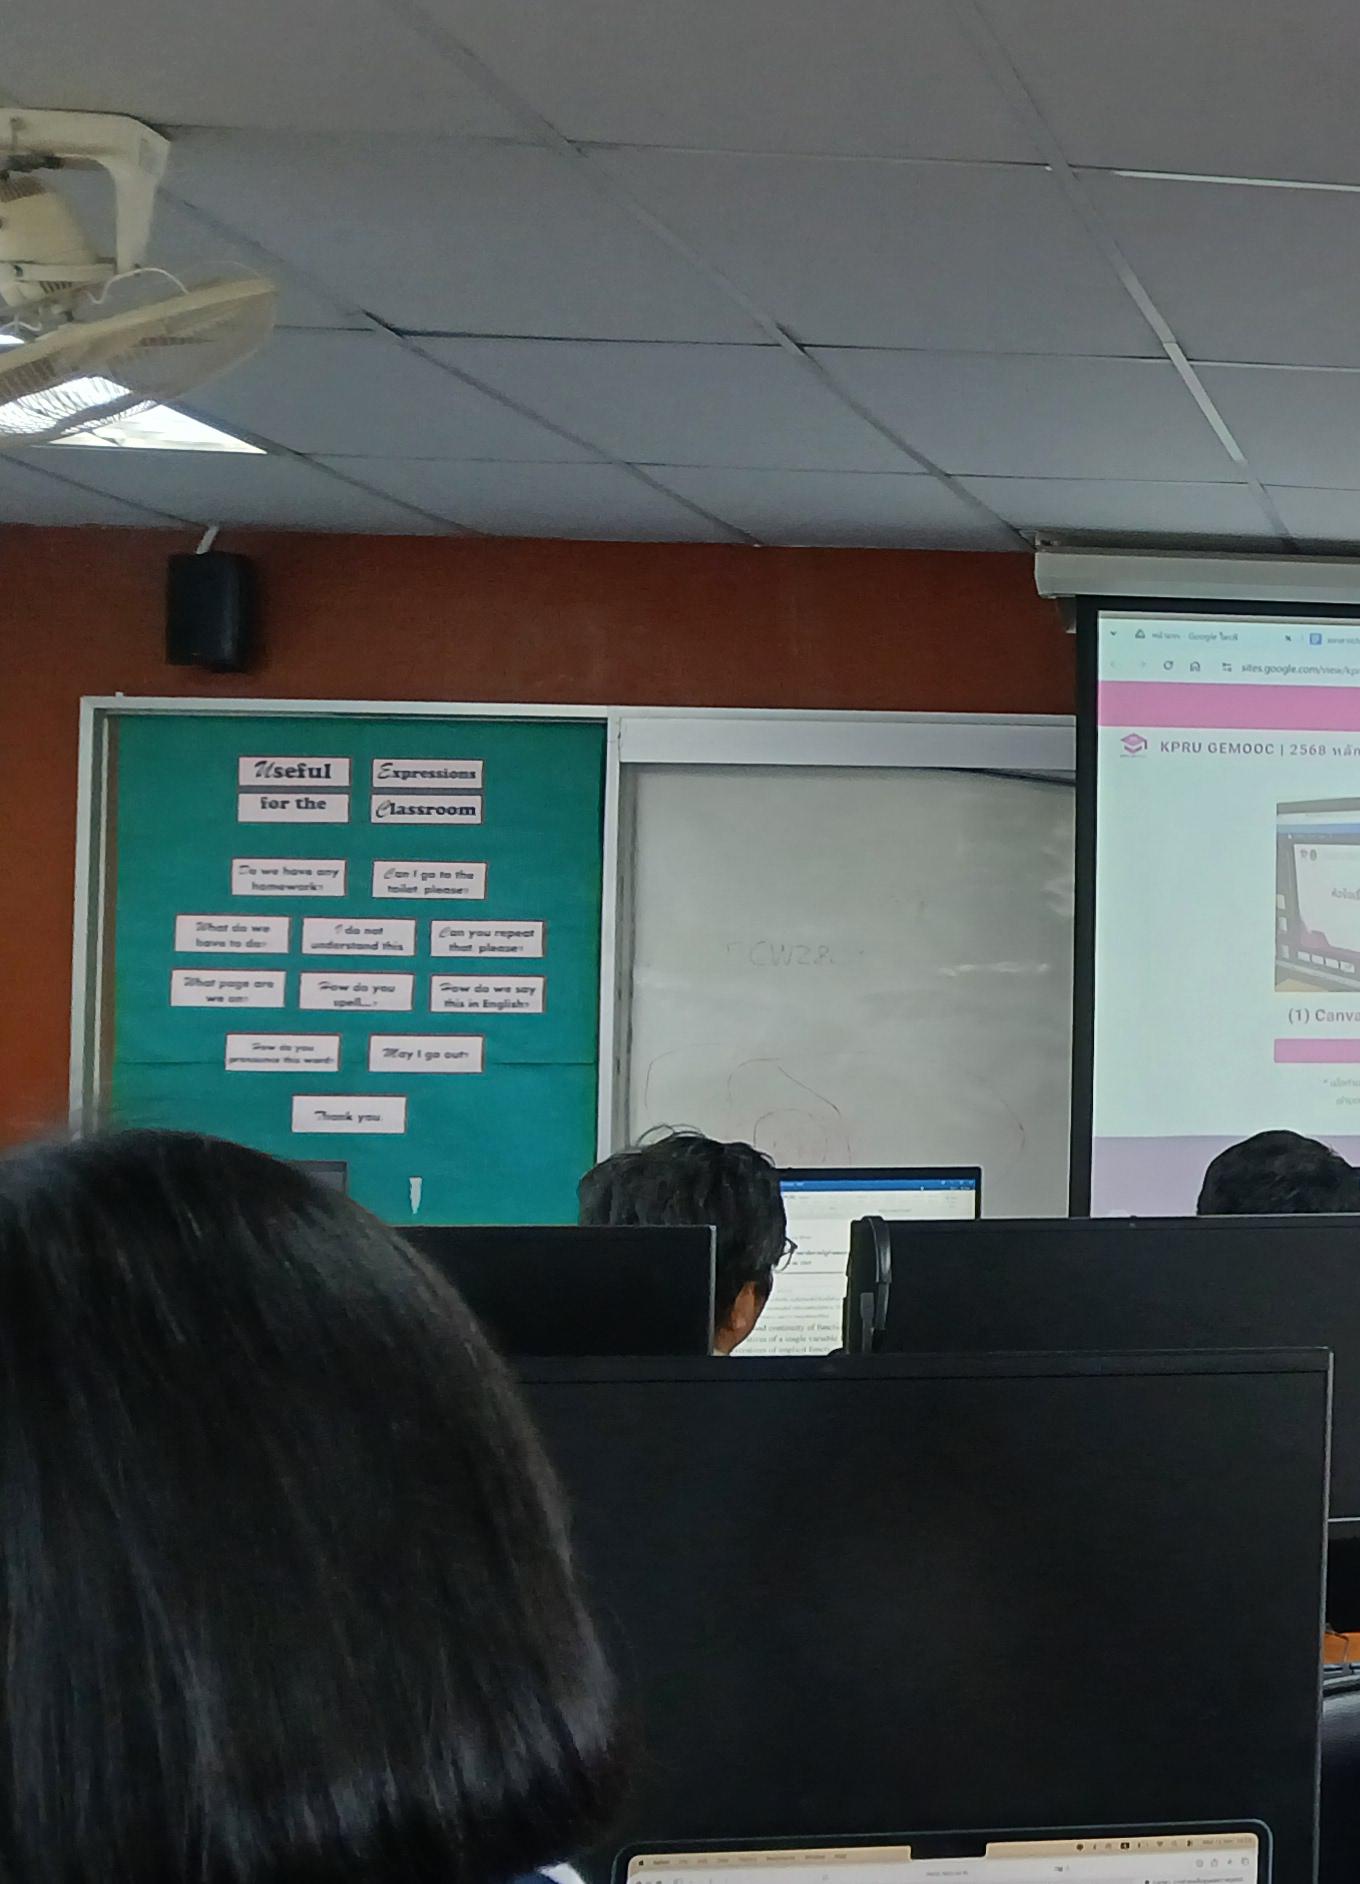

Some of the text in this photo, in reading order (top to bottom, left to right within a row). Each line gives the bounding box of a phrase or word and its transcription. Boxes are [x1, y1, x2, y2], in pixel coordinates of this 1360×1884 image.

[1160, 741, 1202, 754] KPRU
[1207, 742, 1274, 755] GEMOOC
[1290, 744, 1326, 757] 2568
[254, 760, 332, 780] Useful
[377, 762, 477, 781] Expressions
[260, 797, 327, 810] for the
[375, 800, 477, 818] Classroom
[420, 872, 436, 881] go
[440, 871, 452, 879] to
[455, 869, 475, 880] the
[232, 922, 248, 933] do
[251, 924, 270, 933] we
[345, 925, 362, 935] do
[468, 929, 492, 940] you
[229, 939, 243, 948] to
[352, 981, 369, 992] do
[371, 983, 396, 994] you
[474, 984, 490, 993] do
[468, 998, 480, 1008] in
[1287, 1008, 1310, 1024] (1)
[424, 1052, 441, 1061] go
